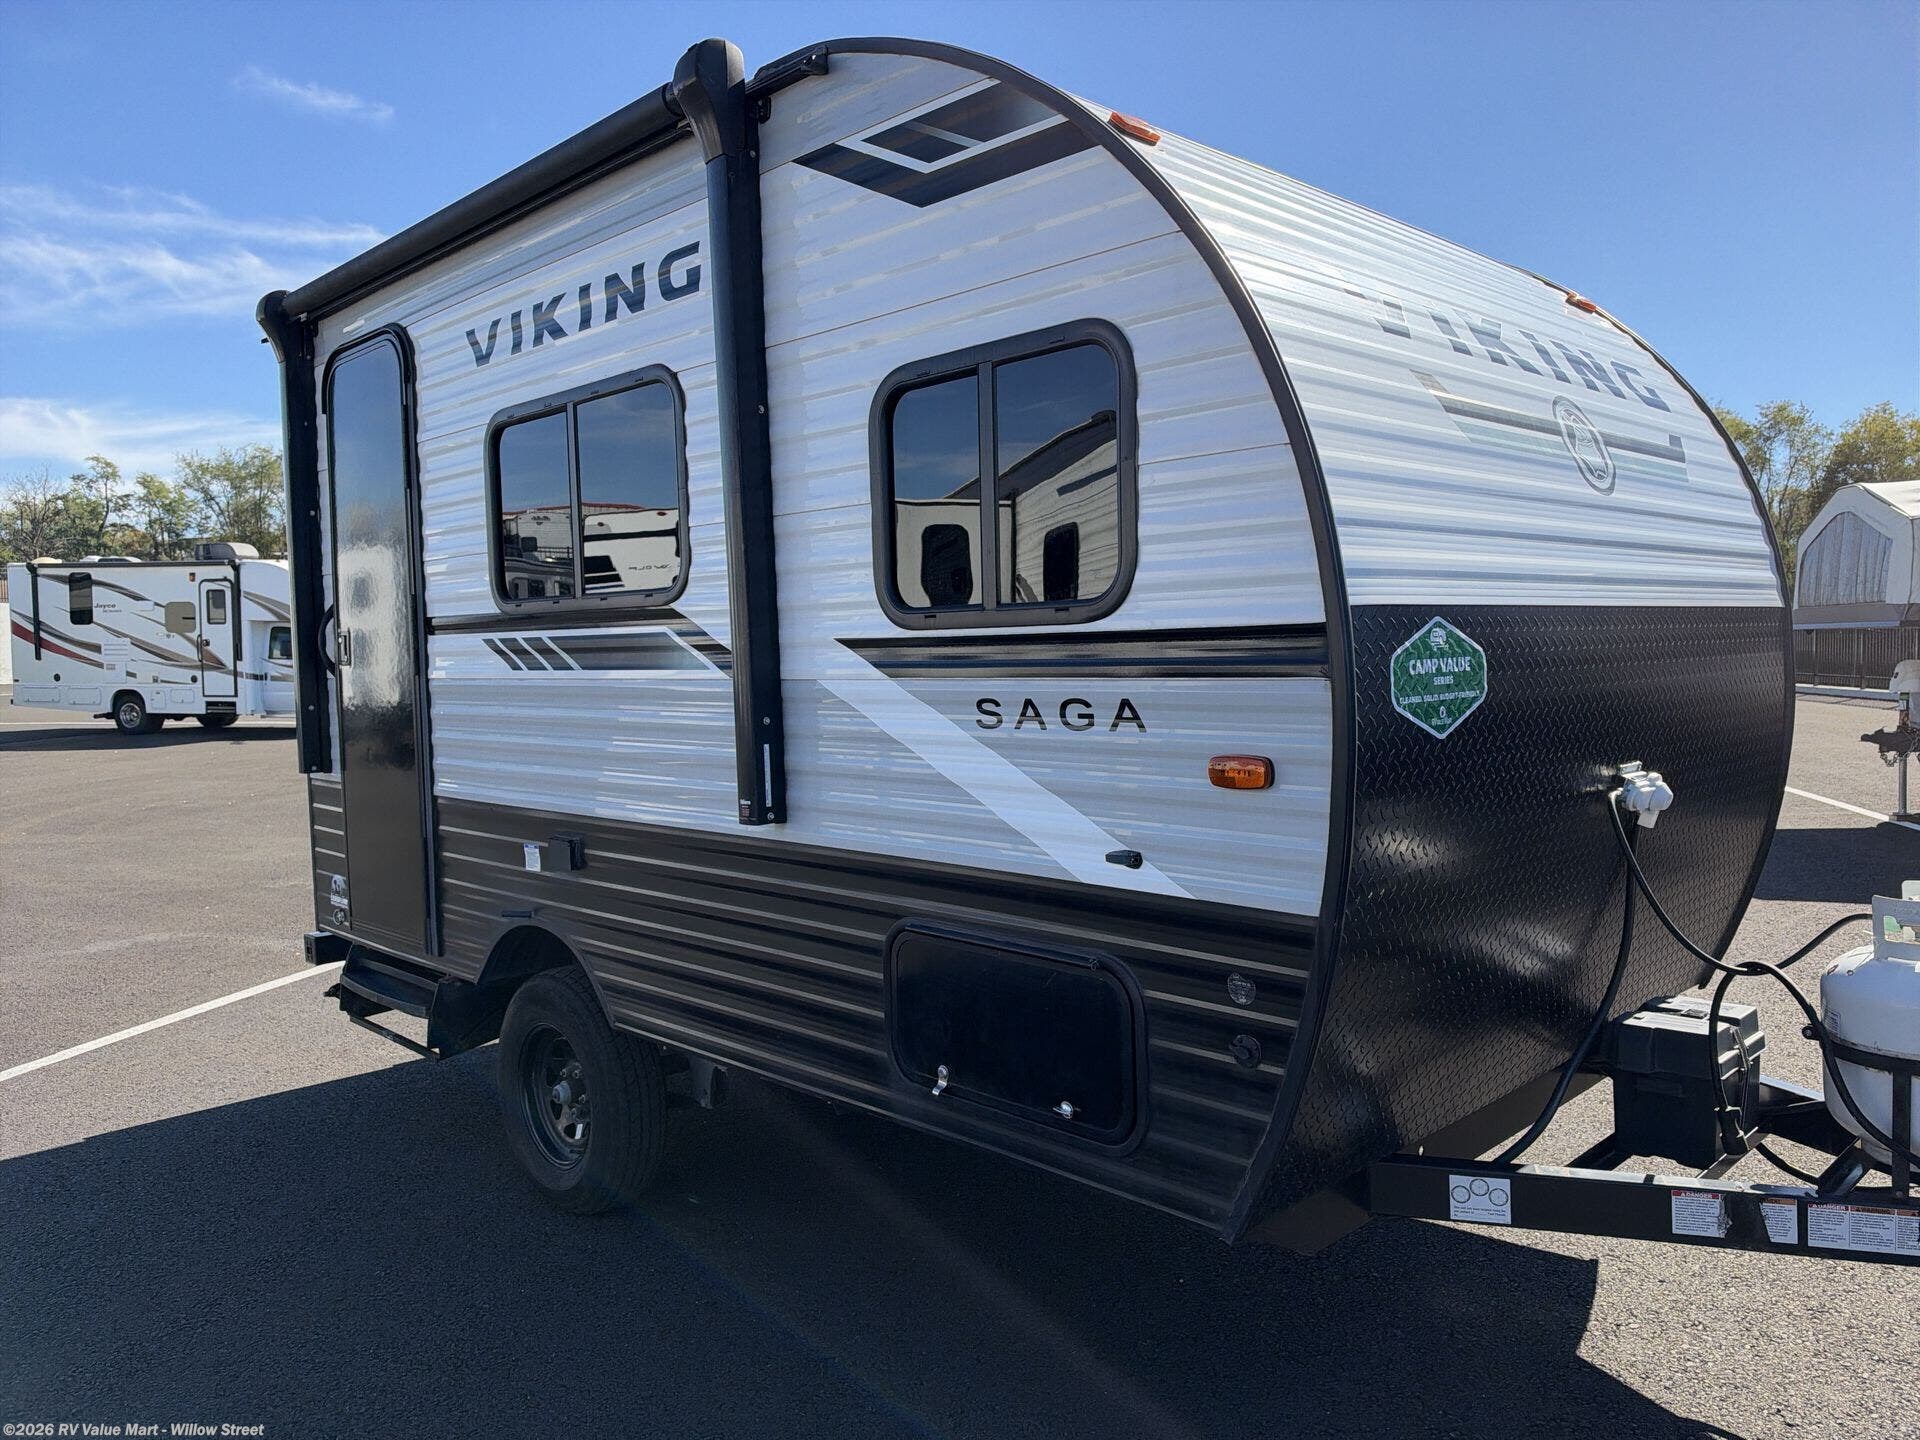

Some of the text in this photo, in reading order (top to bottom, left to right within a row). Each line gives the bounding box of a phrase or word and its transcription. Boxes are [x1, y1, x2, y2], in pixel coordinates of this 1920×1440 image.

[465, 240, 702, 368] VIKING
[1409, 656, 1471, 675] CAMP VALUE
[1433, 676, 1454, 685] SERIES
[976, 697, 1148, 733] SAGA
[1686, 1191, 1713, 1199] DANGER
